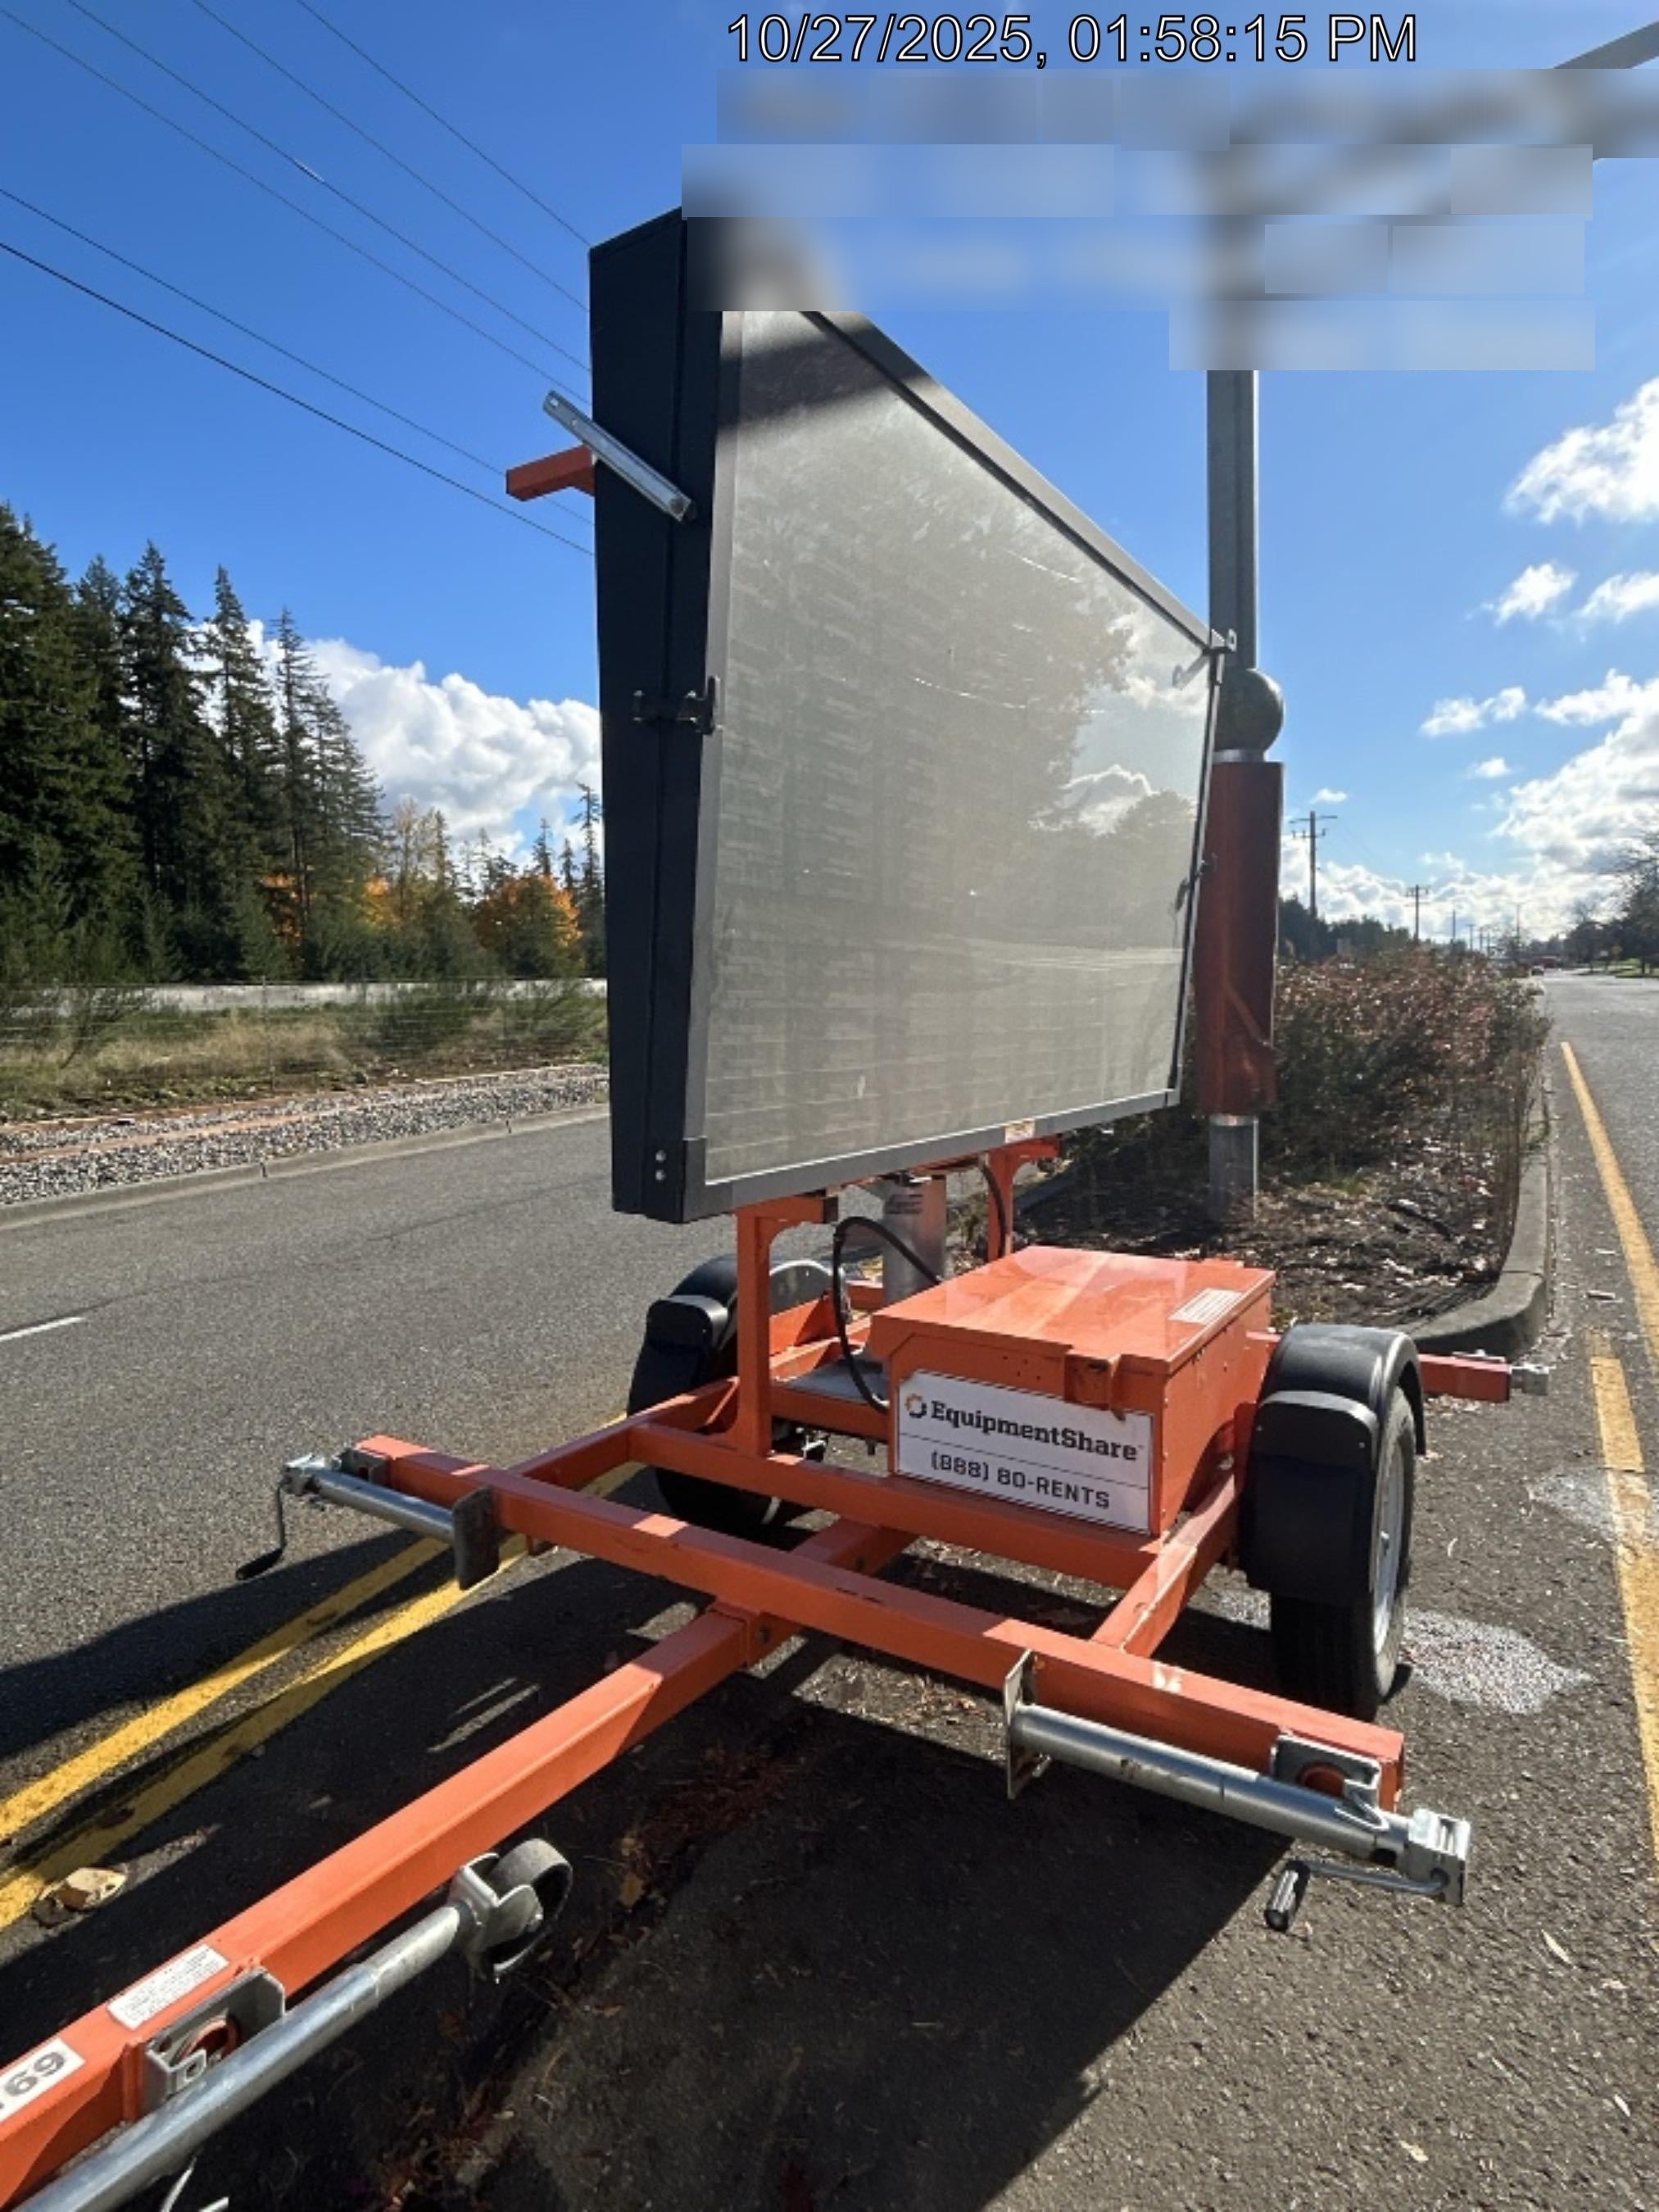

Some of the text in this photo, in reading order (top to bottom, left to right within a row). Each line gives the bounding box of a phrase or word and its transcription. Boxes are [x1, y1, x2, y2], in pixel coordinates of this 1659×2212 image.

[931, 1400, 1137, 1461] EquipmentShare
[931, 1451, 1110, 1509] (888) 80-RENTS
[0, 2051, 65, 2110] 69
